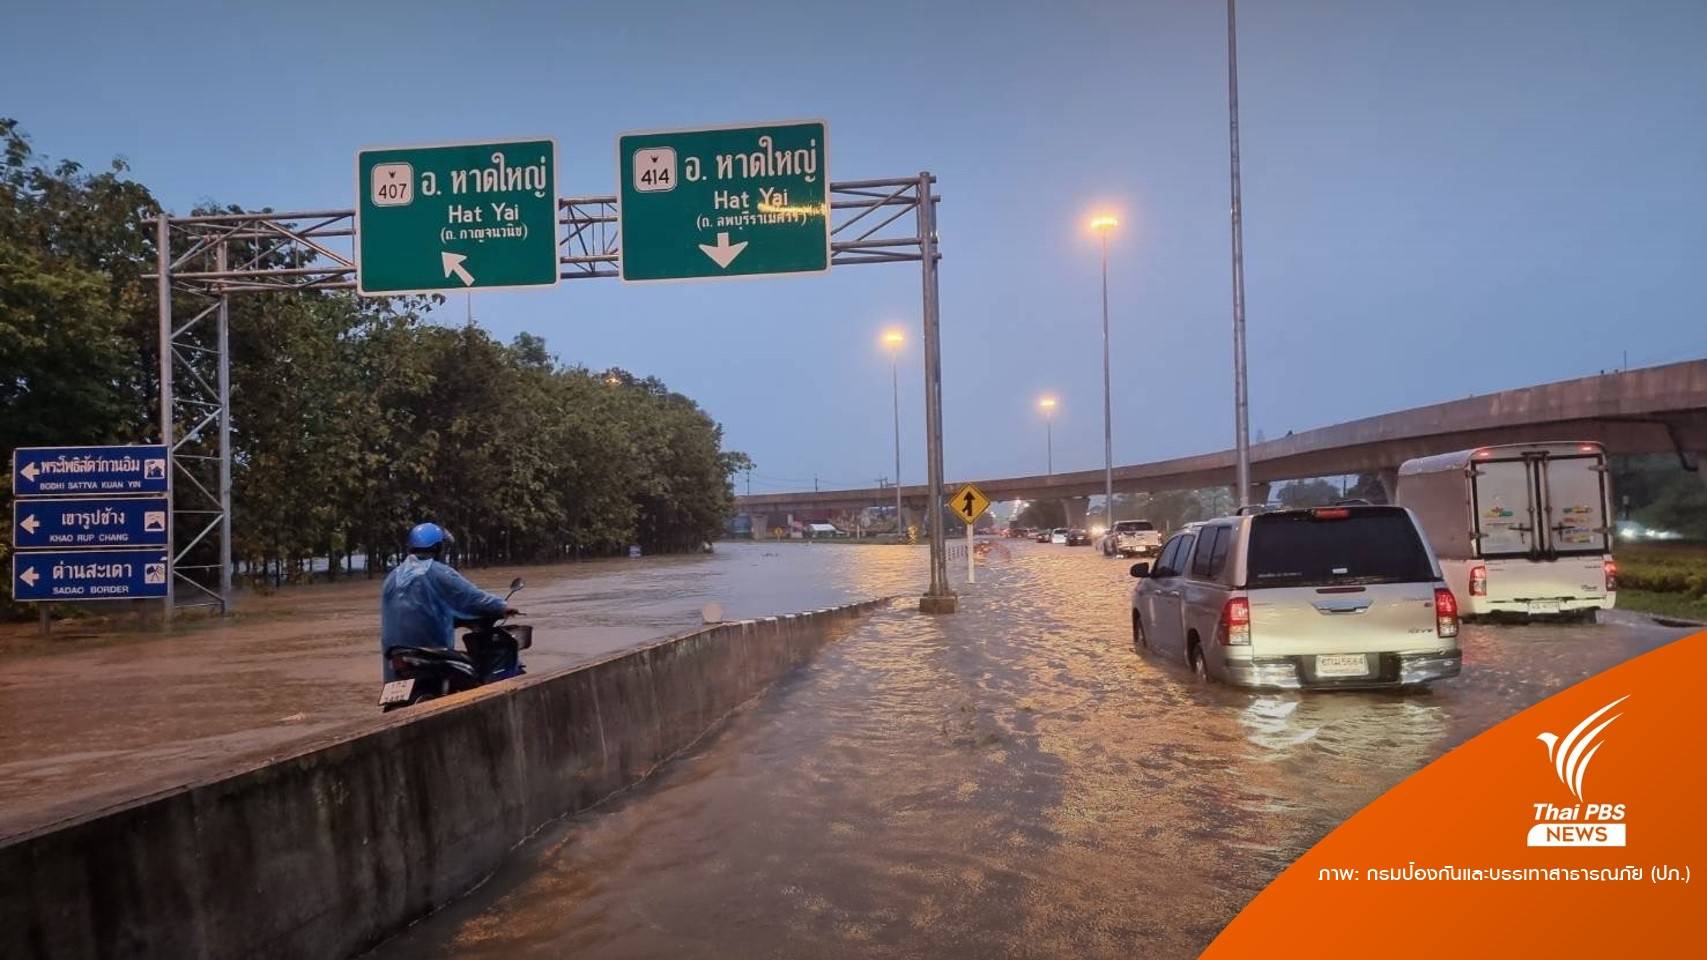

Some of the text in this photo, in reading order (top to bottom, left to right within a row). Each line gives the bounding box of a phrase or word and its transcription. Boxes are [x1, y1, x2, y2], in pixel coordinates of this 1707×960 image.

[685, 136, 817, 183] อ. หาดใหญ่
[421, 152, 547, 198] อ. หาดใหญ่
[641, 168, 670, 186] 414
[378, 183, 407, 199] 407
[714, 187, 788, 210] Hat Yai
[449, 202, 519, 223] Hat Yai
[40, 480, 142, 491] BODHI SATTVA KUAN YIN
[62, 507, 125, 530] เขารูปช้าง
[50, 533, 129, 543] KHAO RUP CHANG
[53, 560, 132, 580] ด่านสะเดา
[53, 585, 129, 595] SADAO BORDER
